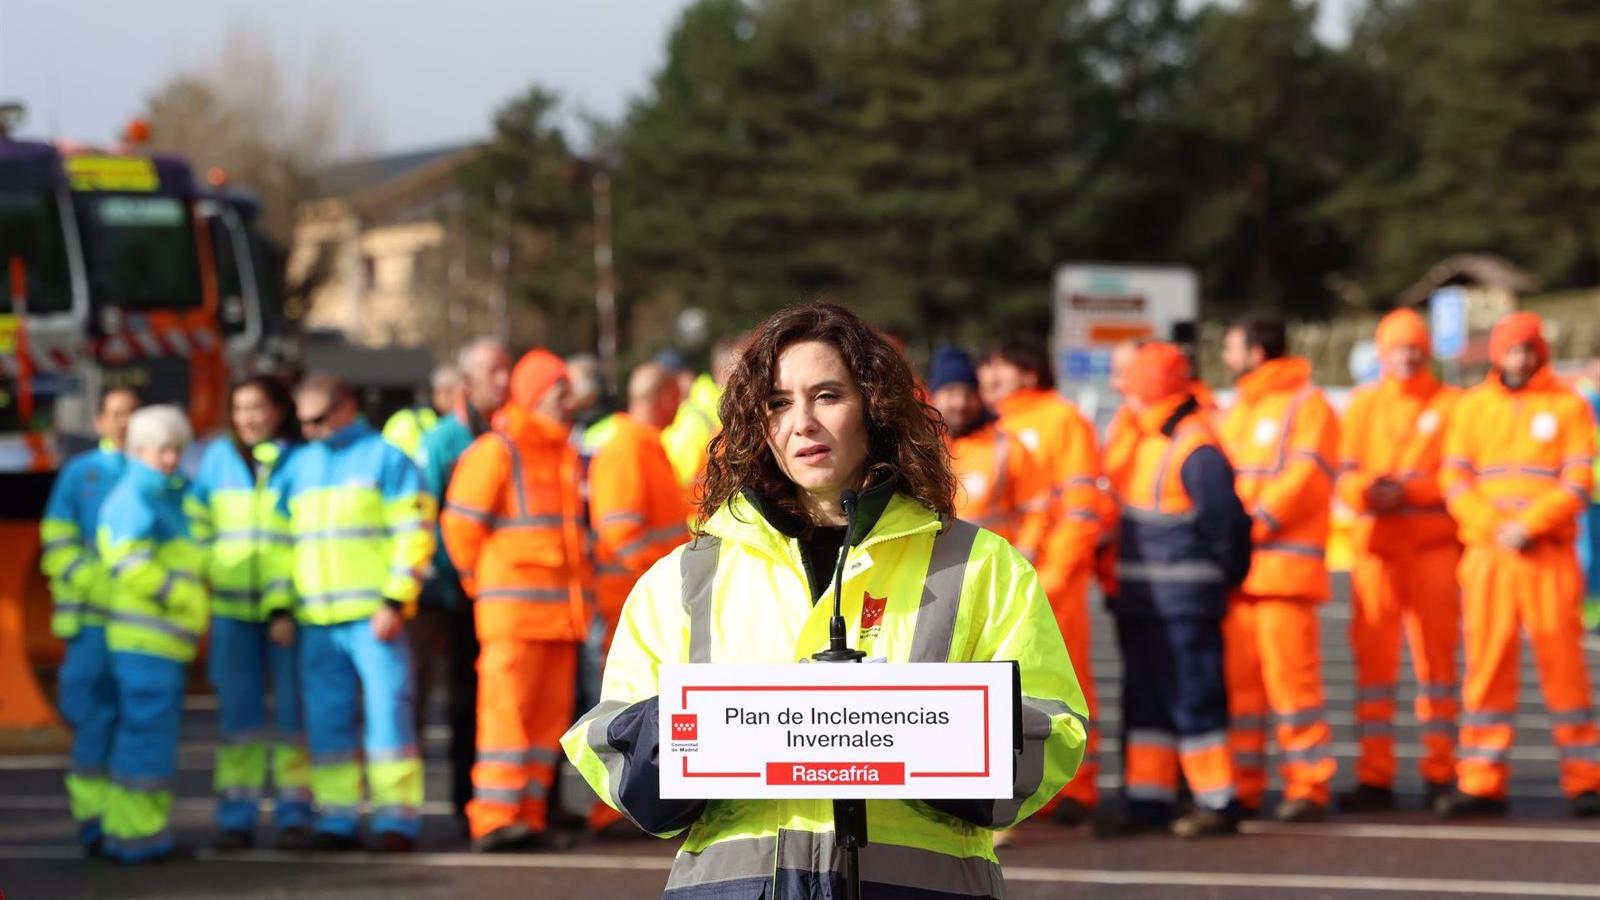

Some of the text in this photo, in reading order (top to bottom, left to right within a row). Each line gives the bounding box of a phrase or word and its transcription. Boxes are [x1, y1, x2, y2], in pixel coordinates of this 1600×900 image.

[725, 707, 950, 725] Plan de Inclemencias
[787, 729, 894, 748] Invernales
[792, 764, 880, 782] Rascafría
